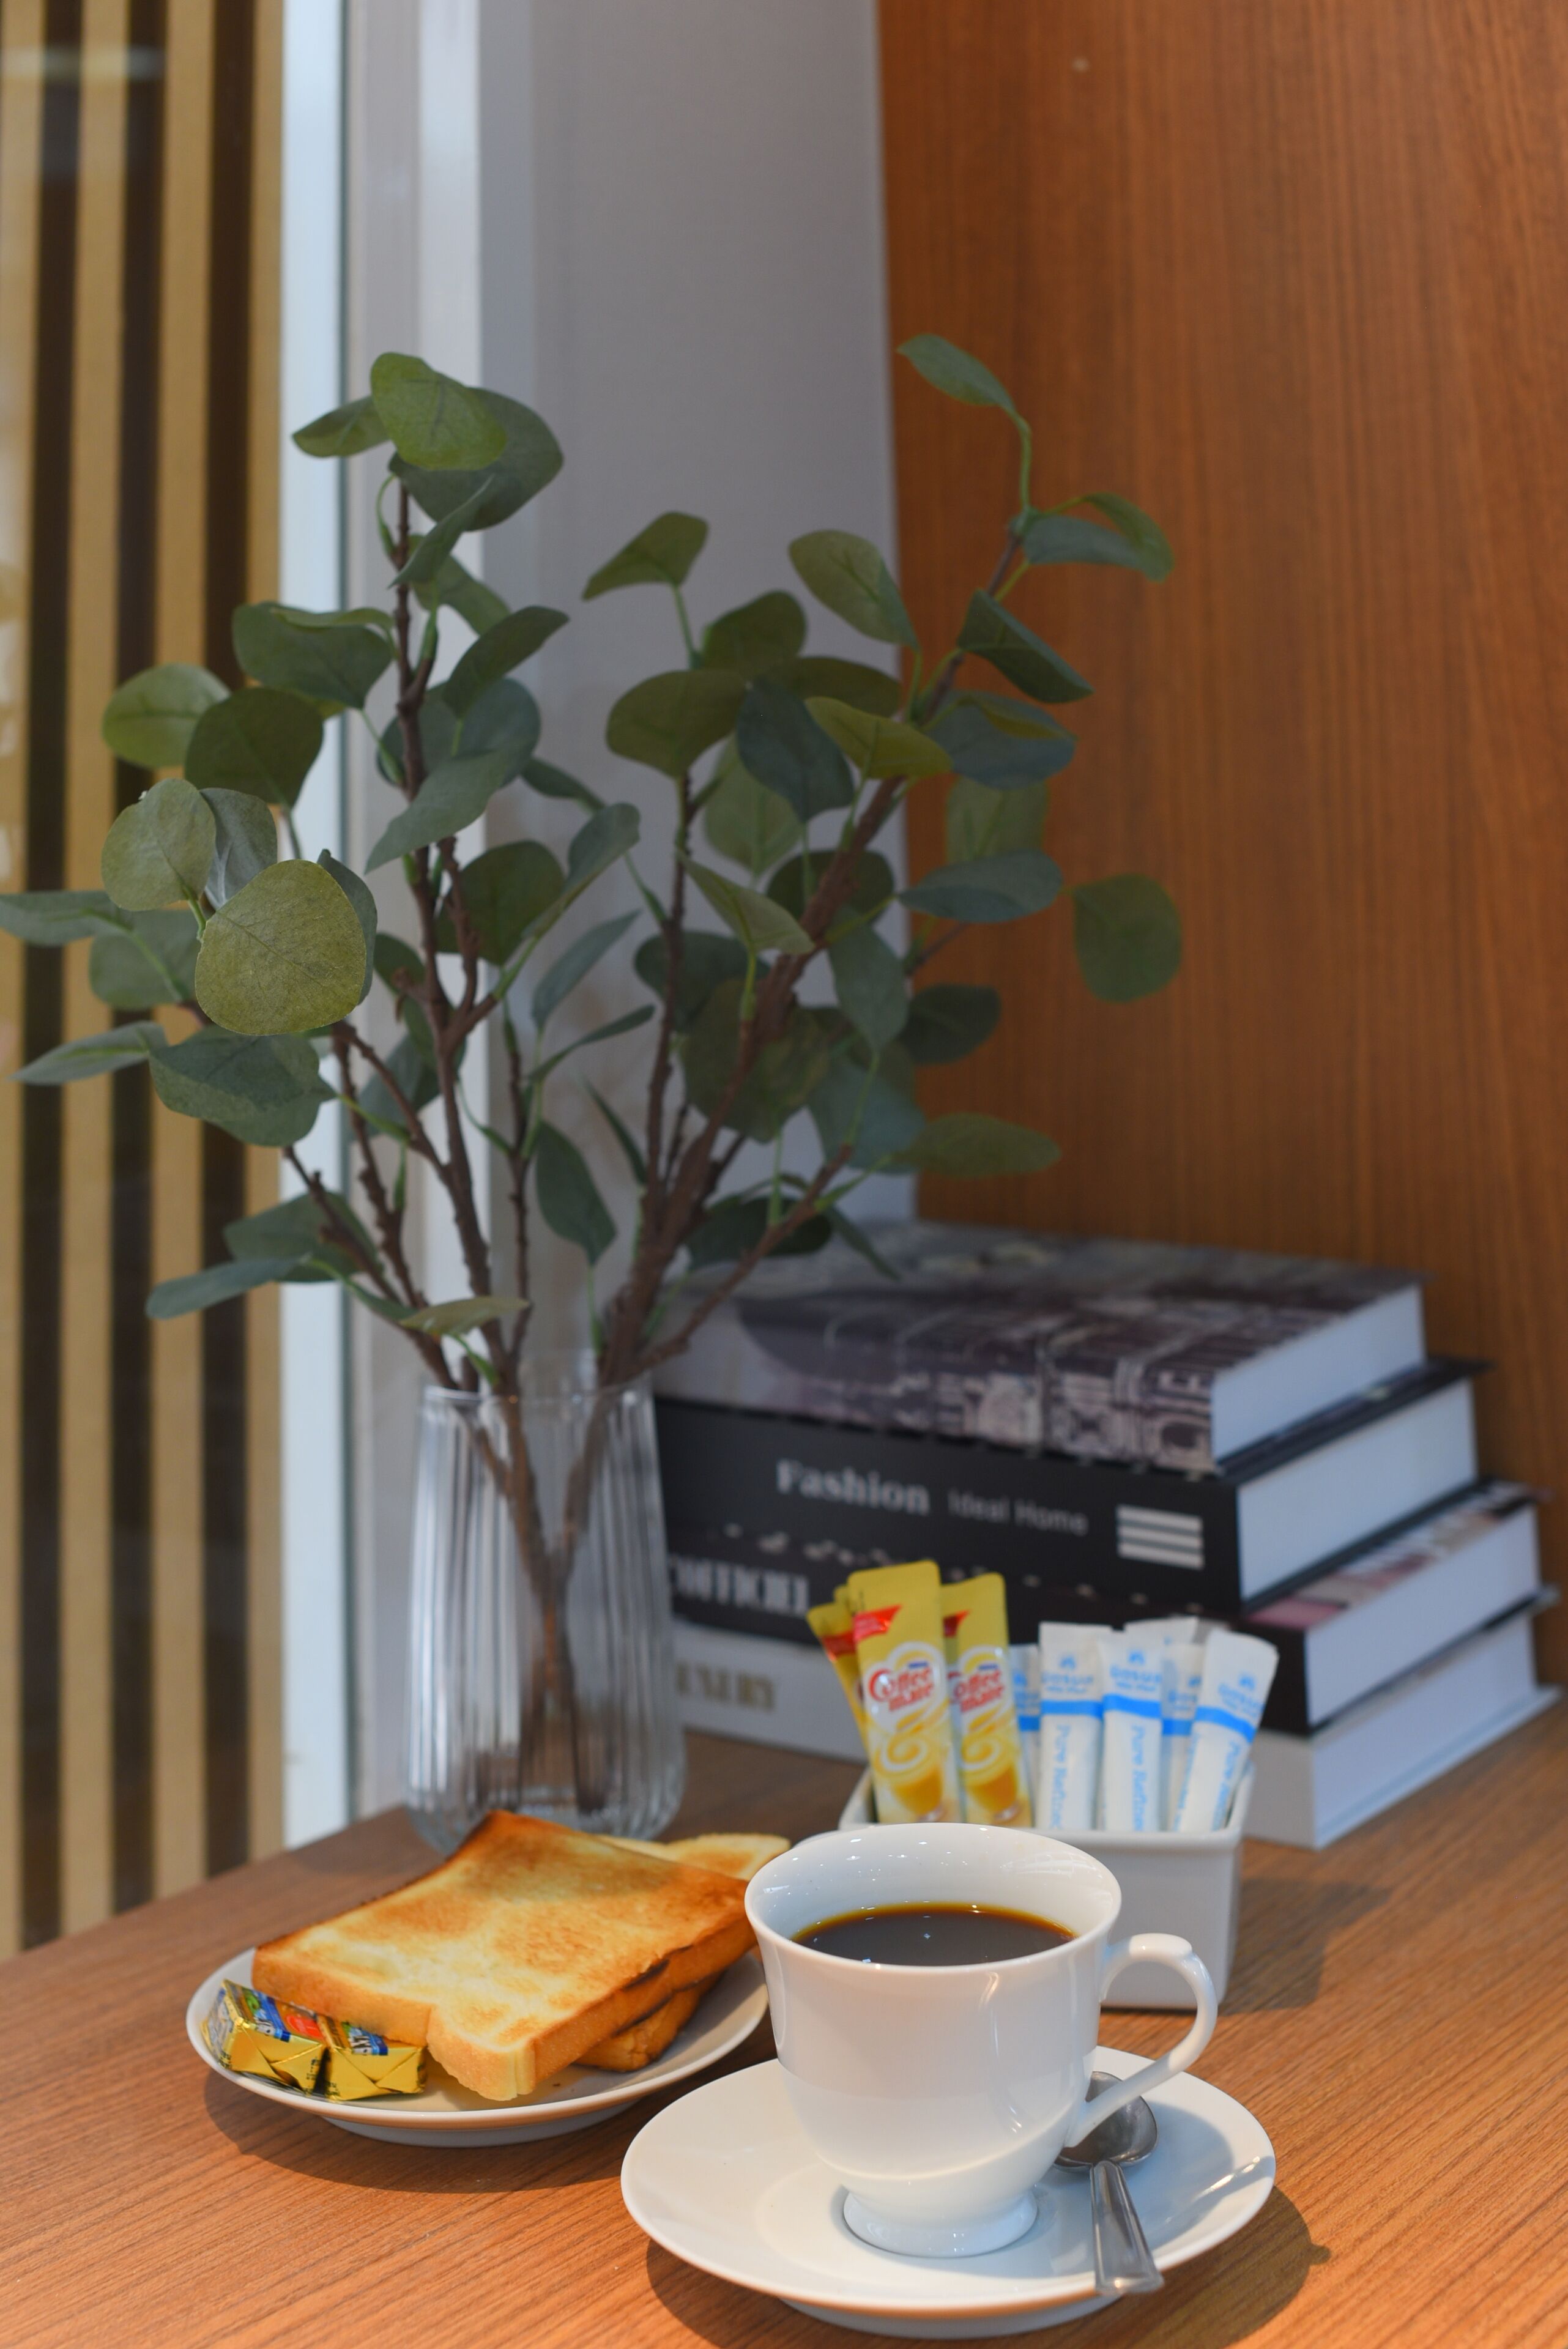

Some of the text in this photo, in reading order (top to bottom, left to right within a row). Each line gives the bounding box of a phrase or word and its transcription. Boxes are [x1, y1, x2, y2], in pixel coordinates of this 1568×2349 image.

[777, 1458, 1089, 1536] Fashion Ideal Home
[869, 1666, 931, 1702] Coffee
[889, 1683, 934, 1712] mate
[1132, 1725, 1146, 1765] Pure
